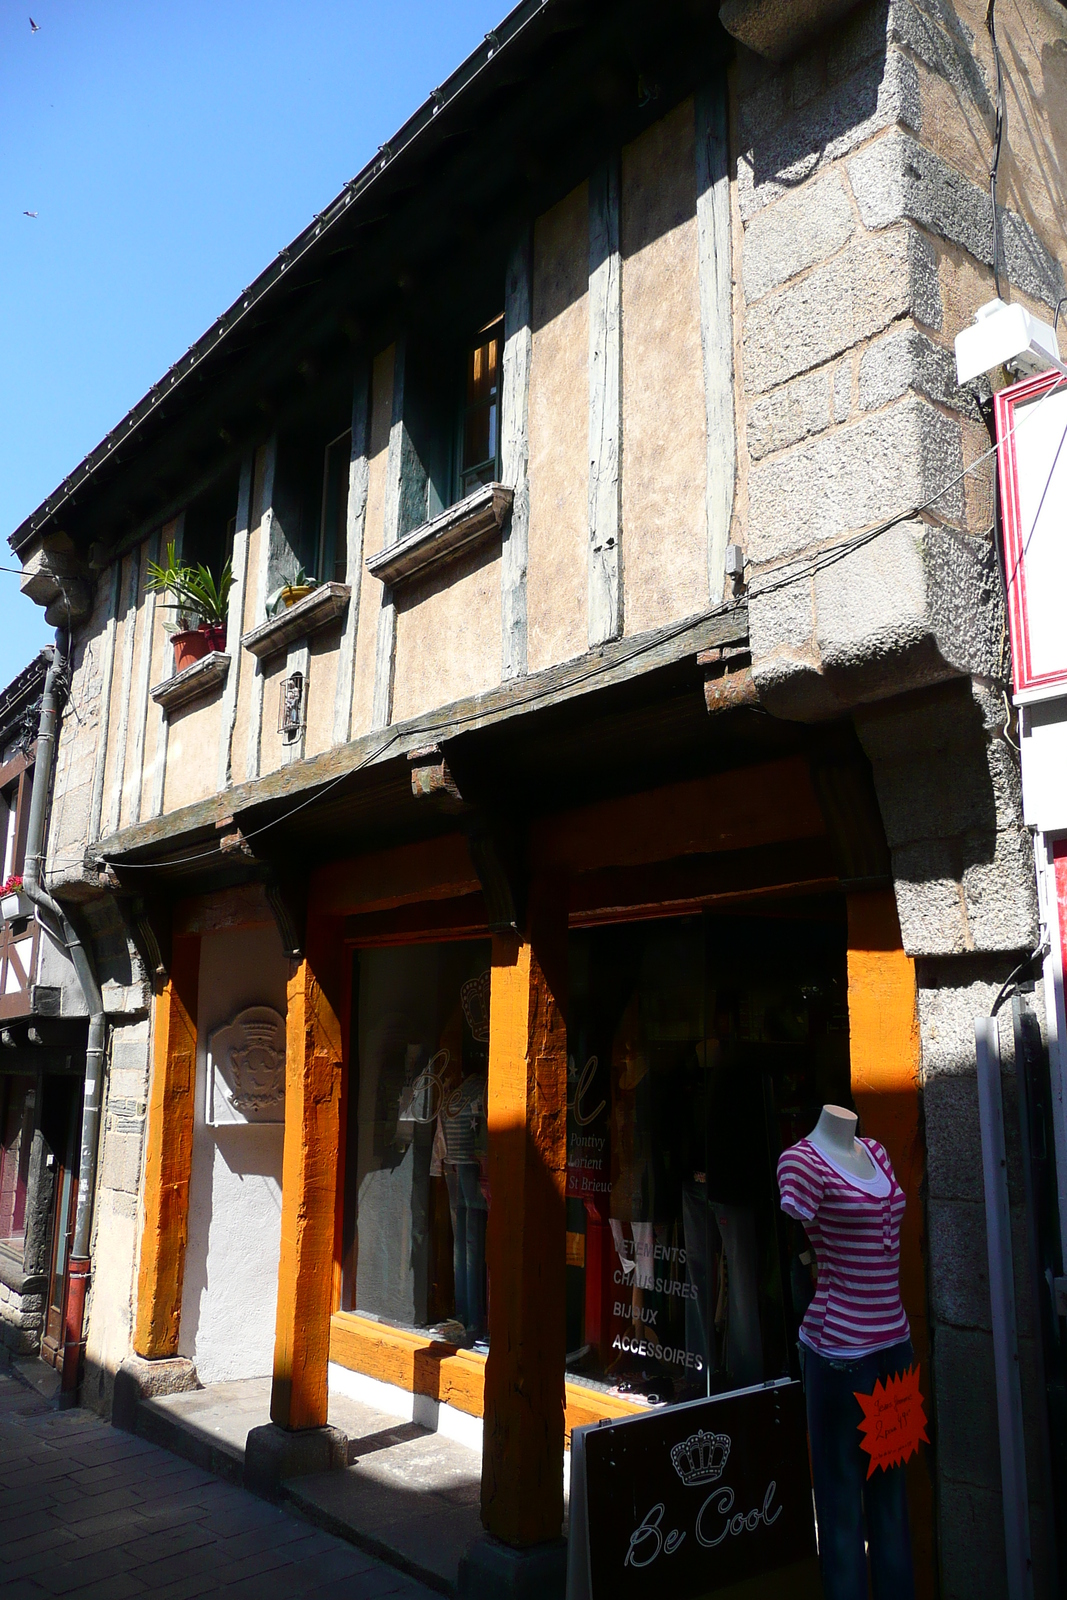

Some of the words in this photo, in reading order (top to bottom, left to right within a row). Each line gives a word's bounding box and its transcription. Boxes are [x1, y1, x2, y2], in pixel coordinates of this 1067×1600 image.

[410, 1048, 471, 1124] Be
[570, 1132, 605, 1152] Pontivy
[568, 1154, 603, 1170] Lorient
[569, 1175, 579, 1190] St
[581, 1177, 613, 1193] Brieuc
[613, 1269, 698, 1300] CHAUSSURES
[613, 1301, 659, 1325] BIJOUX
[612, 1334, 703, 1371] ACCESSOIRES
[624, 1502, 687, 1567] Be
[695, 1480, 783, 1547] Cool
